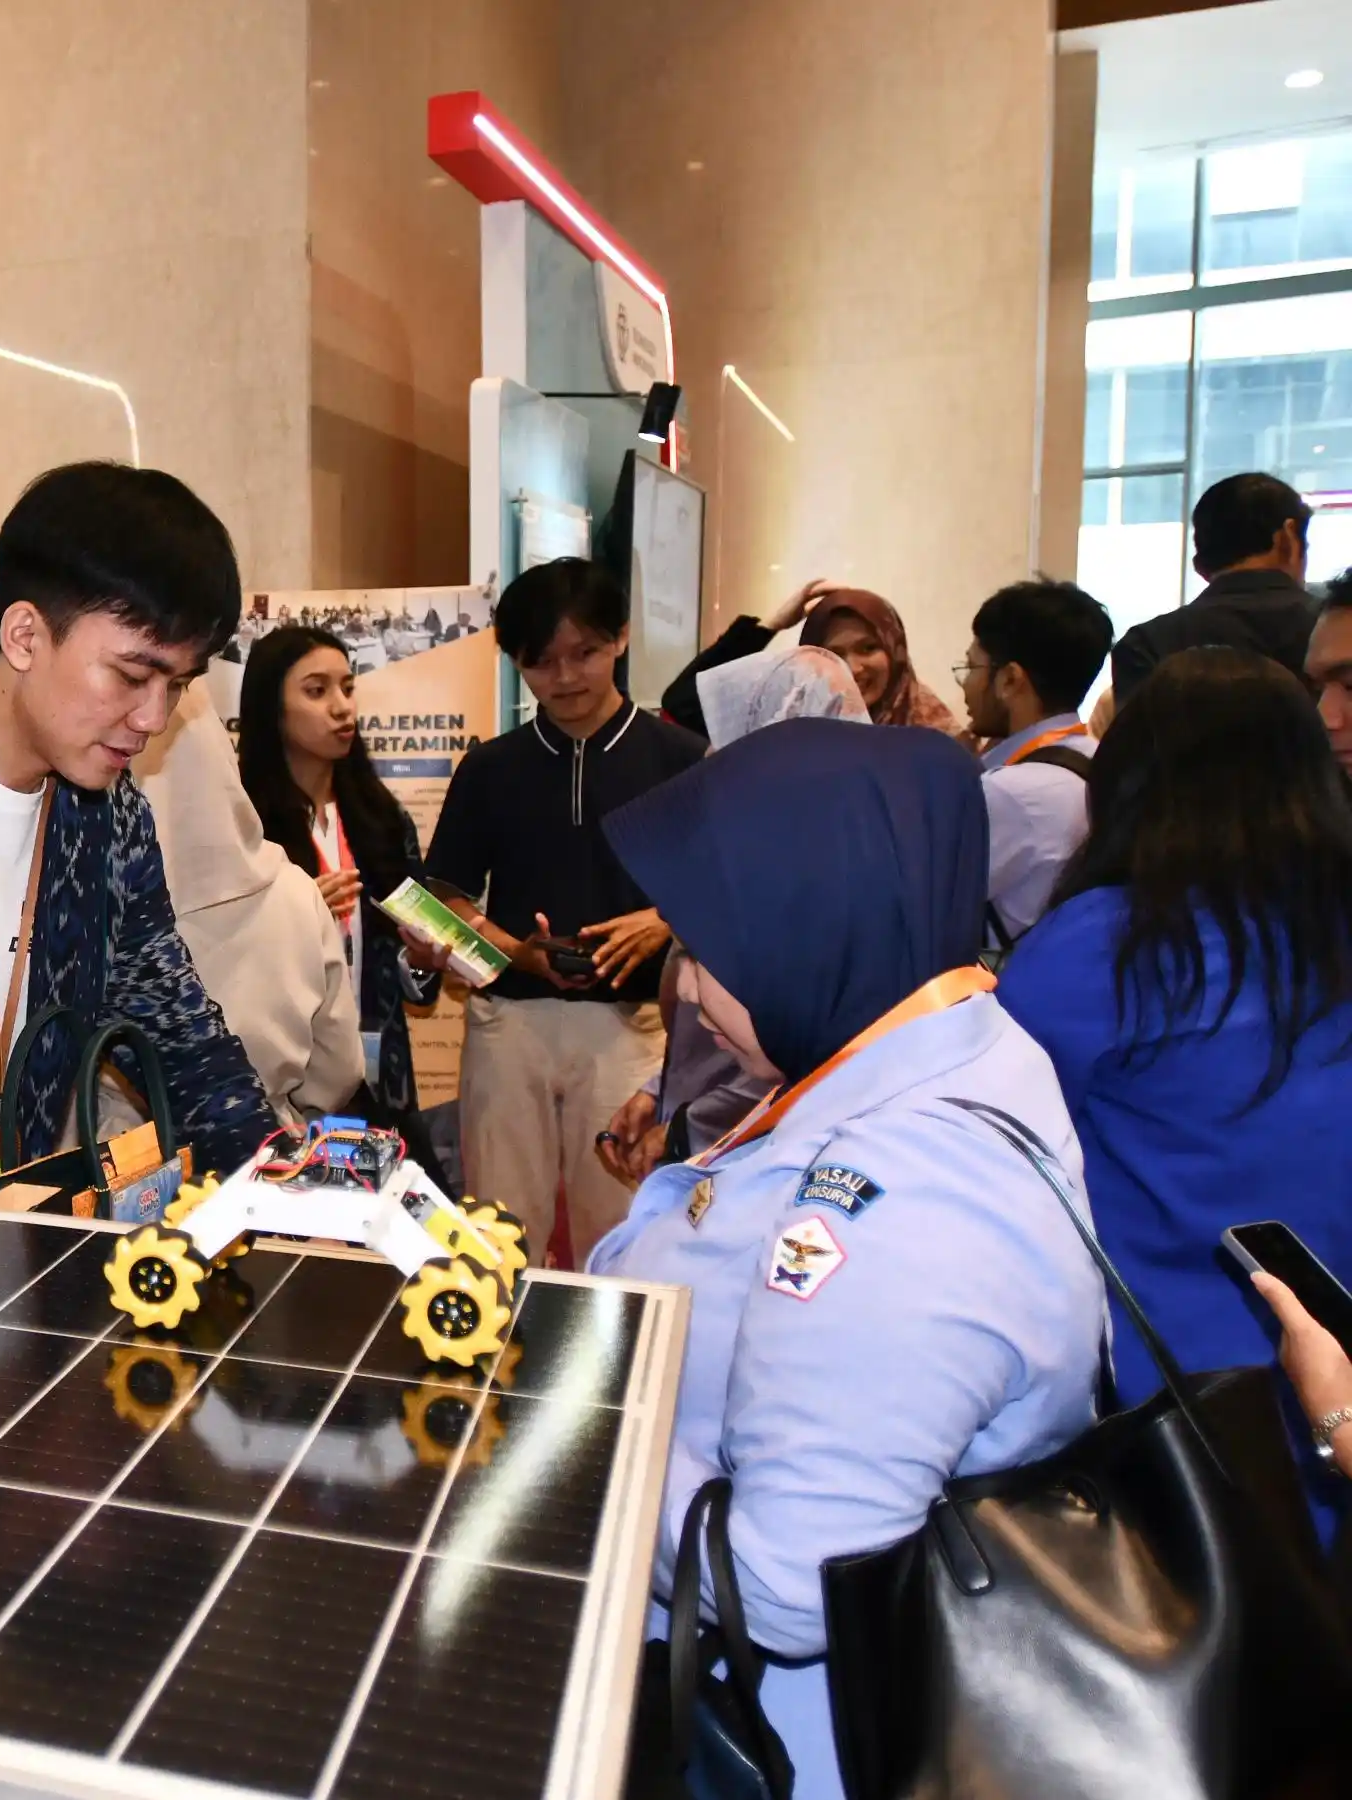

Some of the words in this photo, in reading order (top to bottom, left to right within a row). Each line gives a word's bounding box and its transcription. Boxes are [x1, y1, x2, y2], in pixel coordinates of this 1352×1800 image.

[357, 714, 465, 731] NAJEMEN
[361, 735, 481, 752] ERTAMINA
[804, 1185, 855, 1210] UNSURYA
